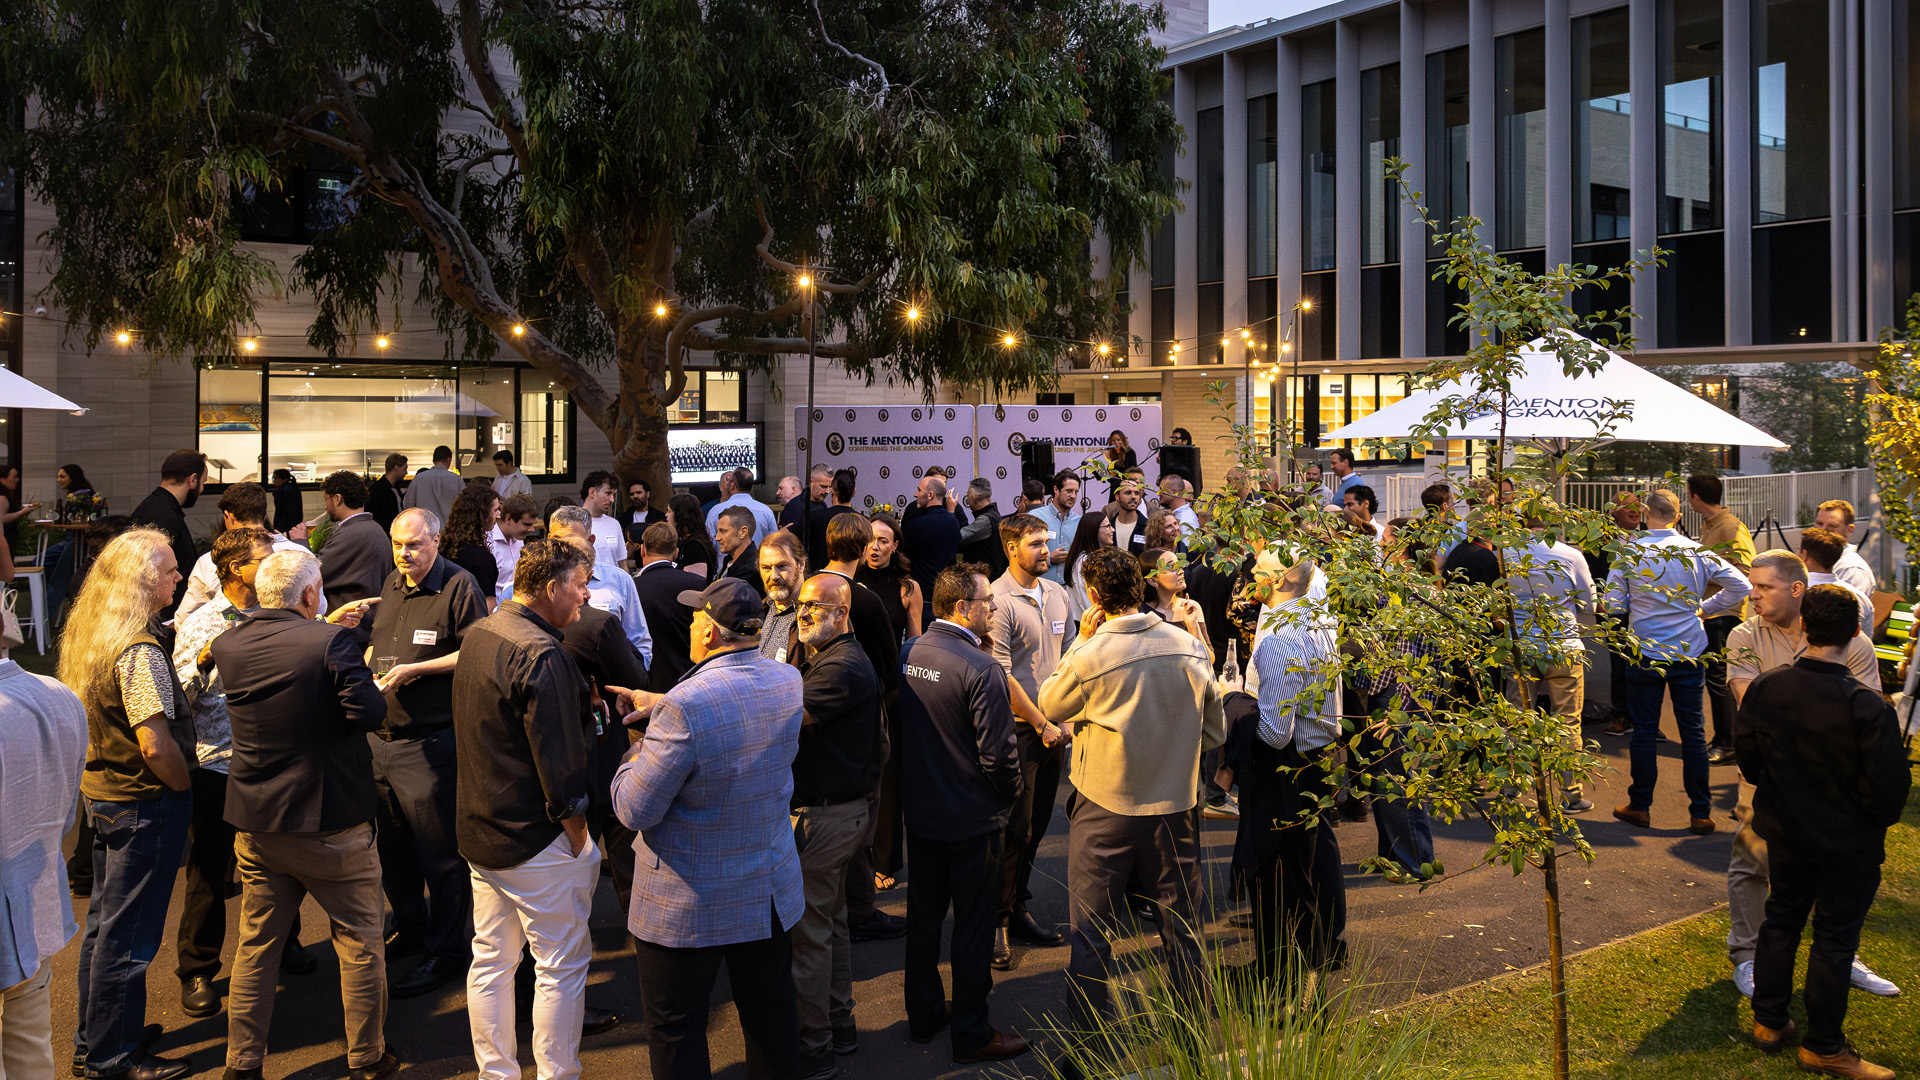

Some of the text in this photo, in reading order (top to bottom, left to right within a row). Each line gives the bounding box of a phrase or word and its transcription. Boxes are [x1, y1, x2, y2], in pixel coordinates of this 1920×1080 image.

[1506, 398, 1635, 409] MENTONE
[848, 436, 944, 445] THE MENTONIANS
[1054, 437, 1110, 446] MENTONI
